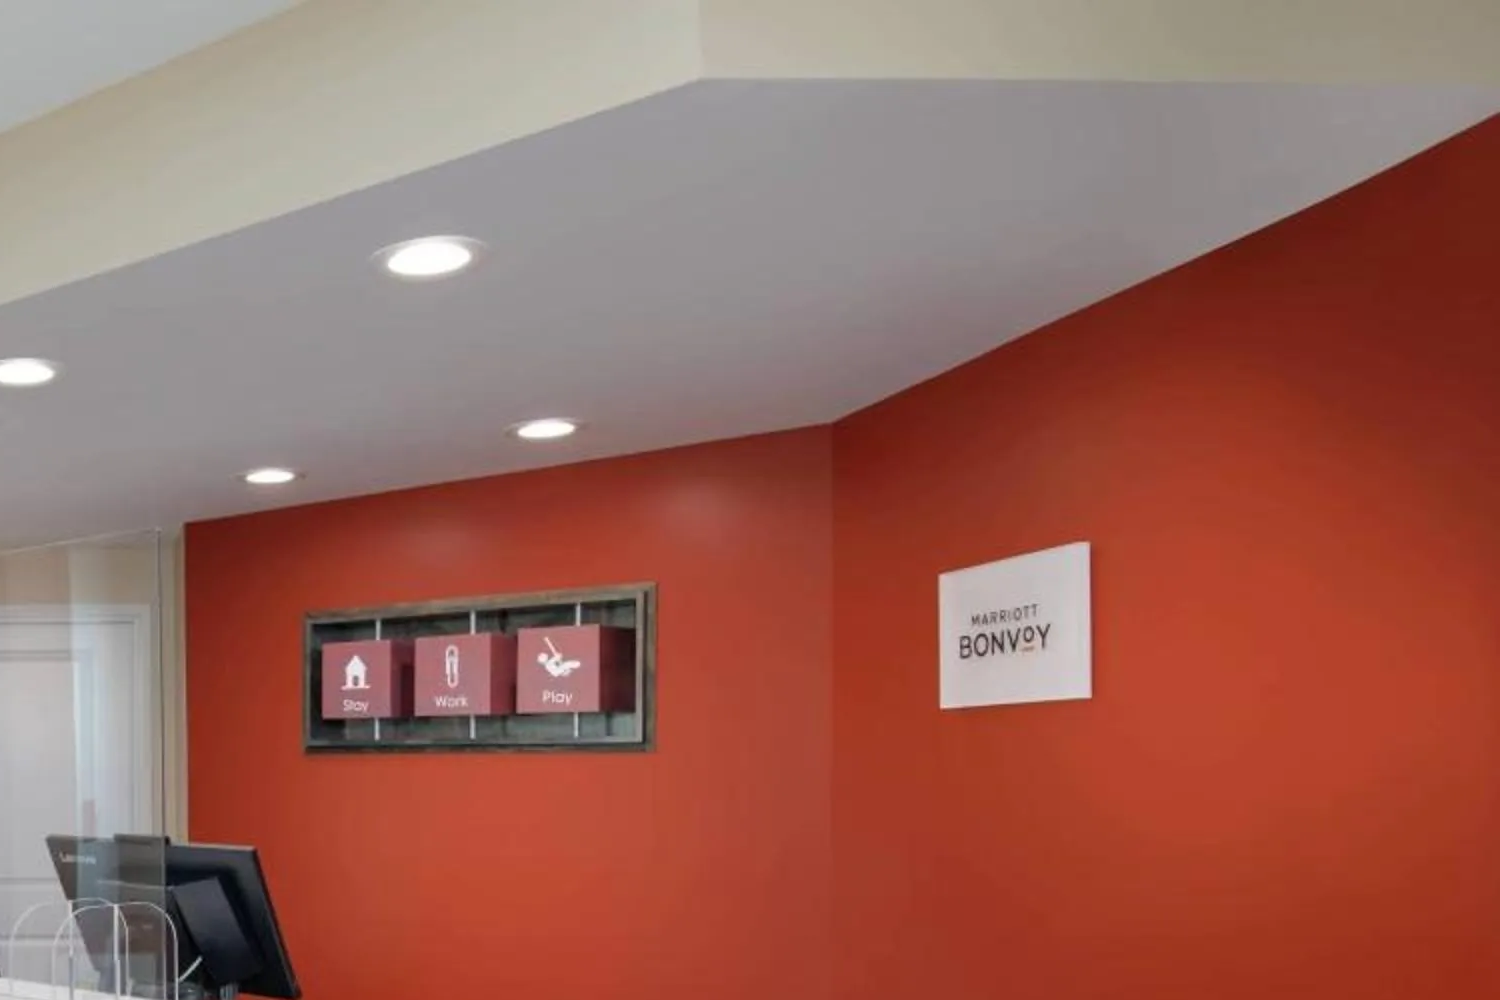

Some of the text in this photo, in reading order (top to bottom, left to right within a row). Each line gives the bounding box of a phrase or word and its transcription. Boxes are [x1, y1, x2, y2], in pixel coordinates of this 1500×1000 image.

[971, 603, 1039, 626] MARRIOTT
[958, 623, 1051, 660] BONVOY
[343, 699, 369, 713] Stay
[434, 695, 469, 708] Work
[542, 689, 573, 706] Play
